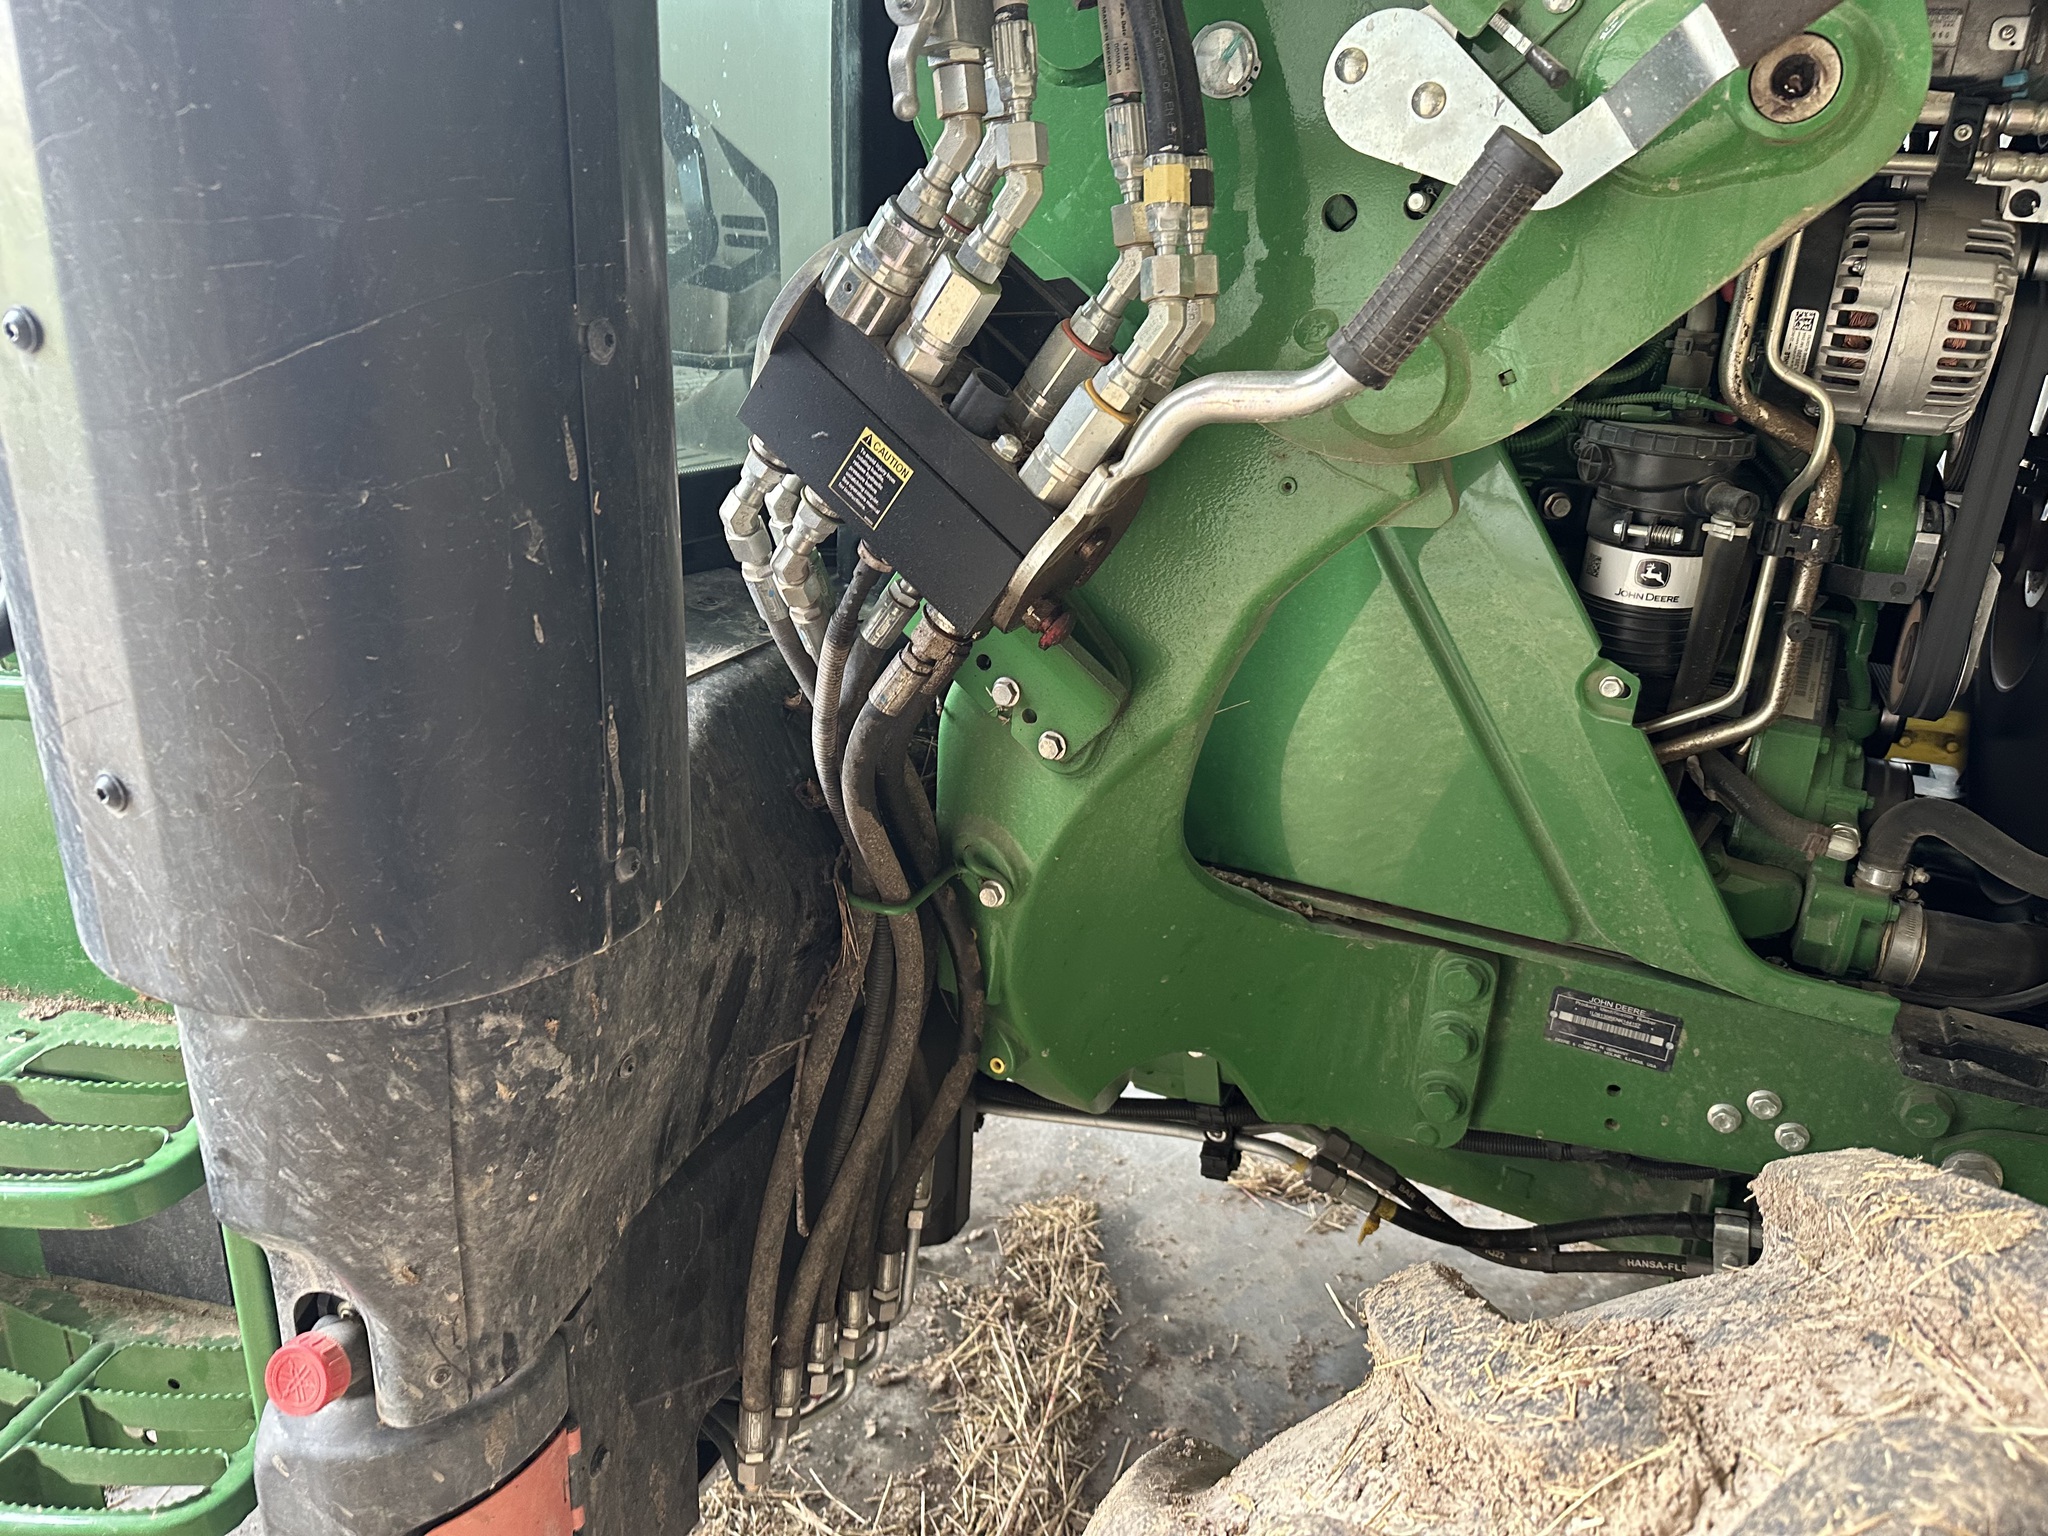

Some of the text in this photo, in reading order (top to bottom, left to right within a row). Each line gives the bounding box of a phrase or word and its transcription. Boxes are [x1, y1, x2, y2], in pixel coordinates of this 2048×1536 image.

[1164, 101, 1174, 116] EN
[872, 441, 909, 478] CAUTION
[1614, 588, 1680, 603] JOHN DEERE
[1575, 1000, 1656, 1025] Product Identification Number
[1588, 996, 1646, 1016] JOHN DEERE
[1554, 1037, 1570, 1045] DEERE
[1605, 1047, 1628, 1056] GERMANY
[1397, 1183, 1416, 1200] BAR
